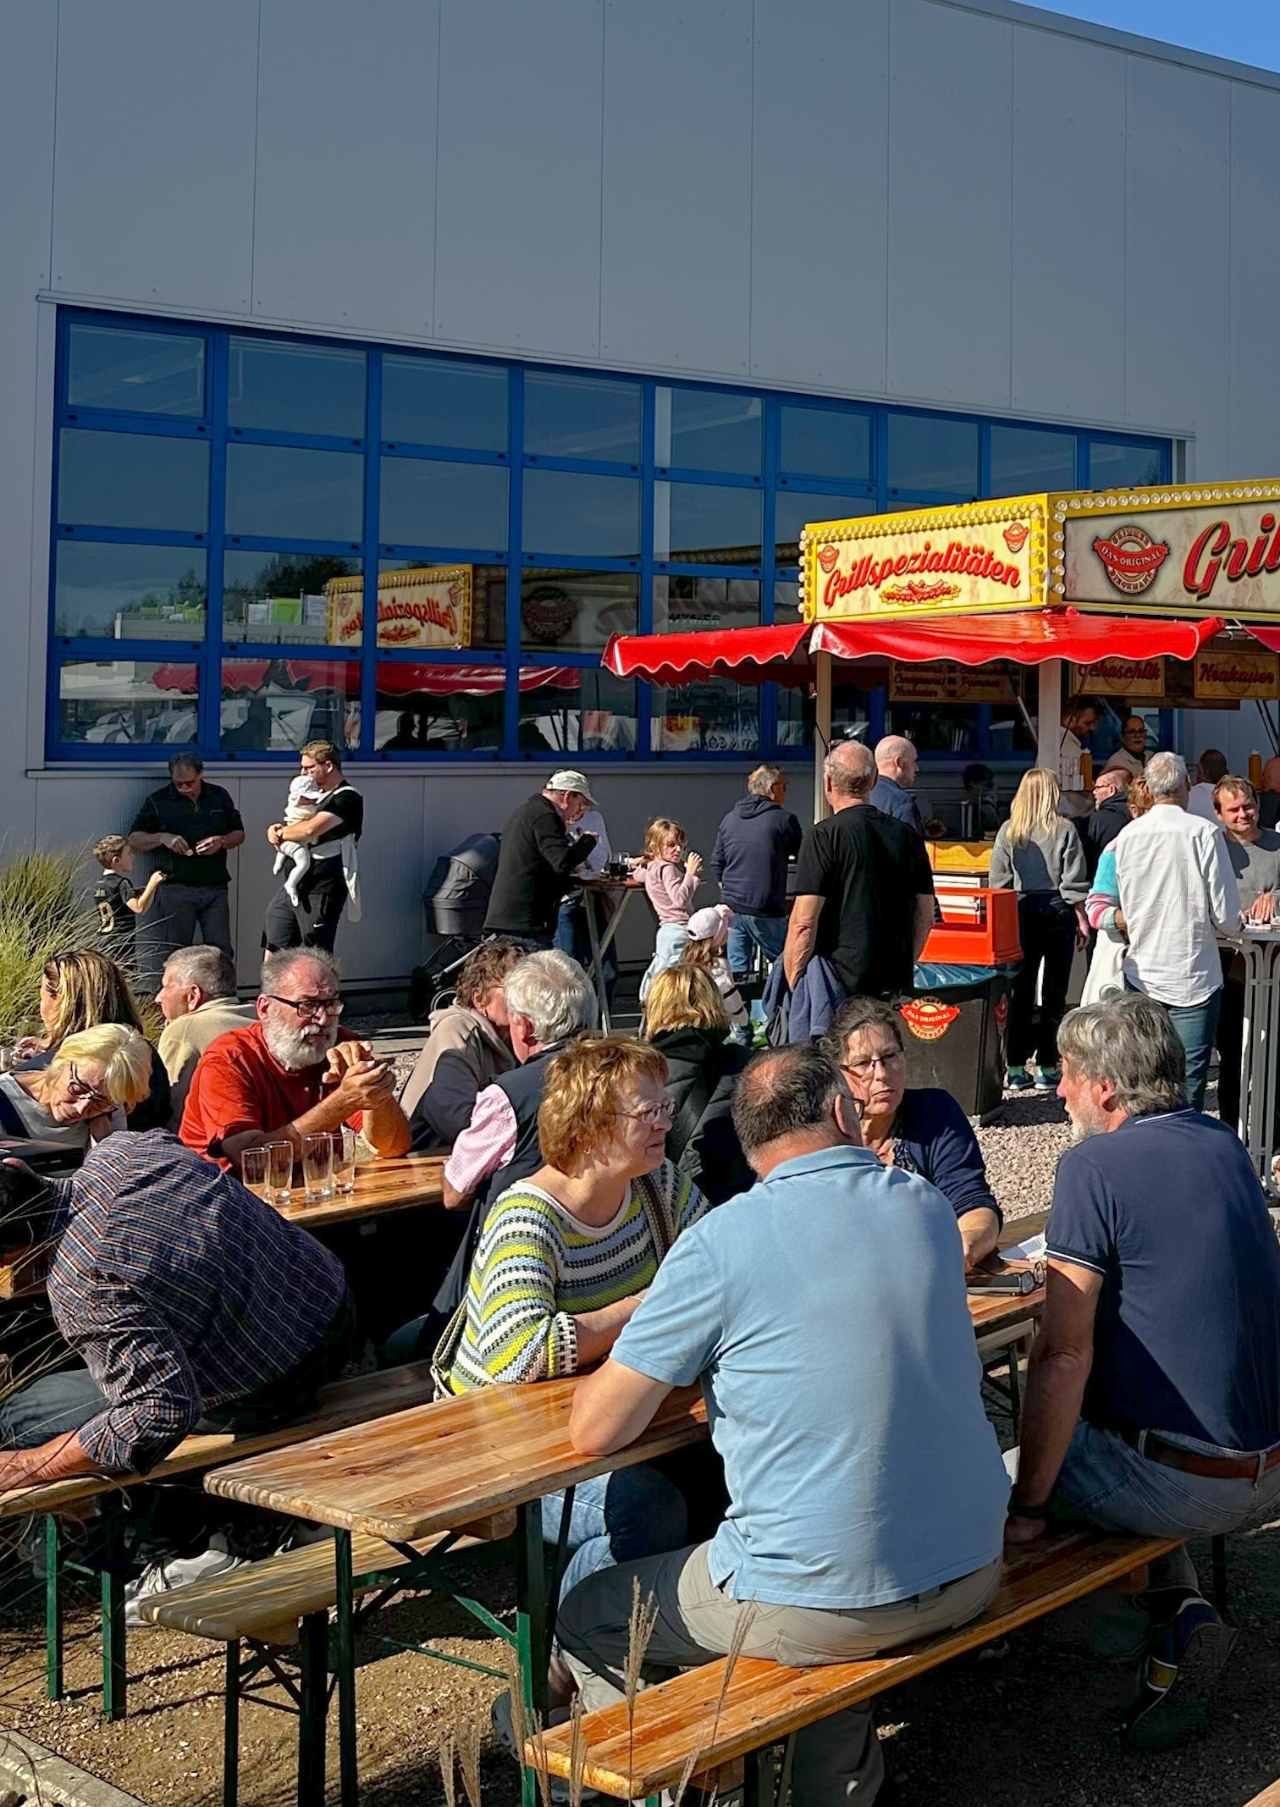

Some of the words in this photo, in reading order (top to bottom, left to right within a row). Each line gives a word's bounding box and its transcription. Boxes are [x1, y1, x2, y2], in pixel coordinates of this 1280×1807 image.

[1101, 546, 1118, 562] DAS
[1120, 550, 1162, 566] ORIGINAL
[823, 541, 1021, 609] Grillspezialitäten
[1199, 662, 1275, 684] Krakauer
